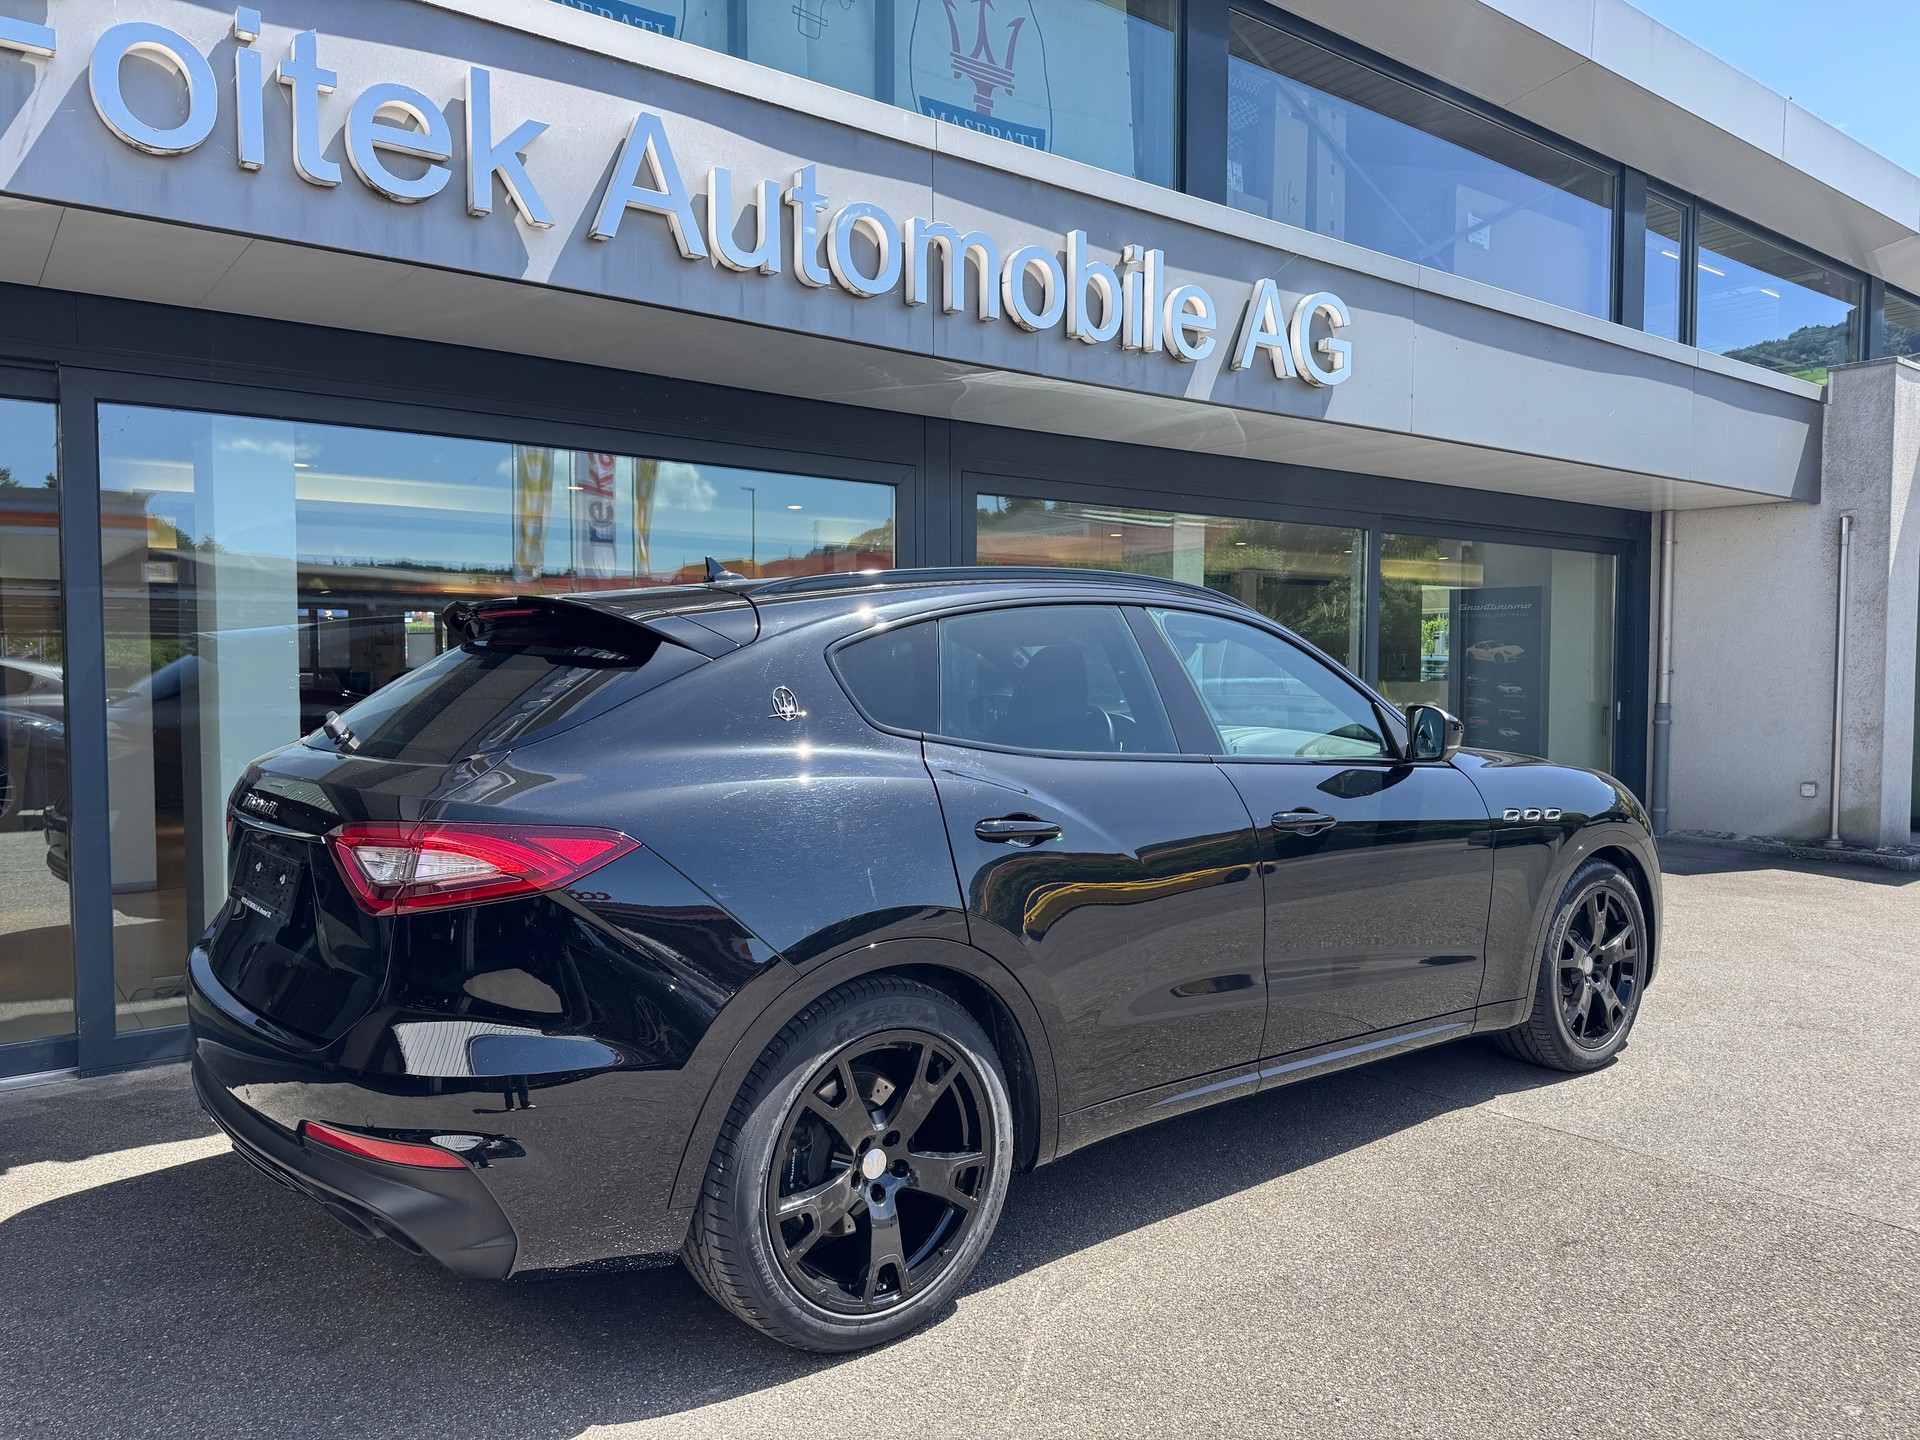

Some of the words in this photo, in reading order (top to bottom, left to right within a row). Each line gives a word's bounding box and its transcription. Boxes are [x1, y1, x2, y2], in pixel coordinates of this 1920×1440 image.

[0, 6, 555, 230] oitek
[588, 111, 1217, 364] Automobile
[1231, 277, 1352, 388] AG
